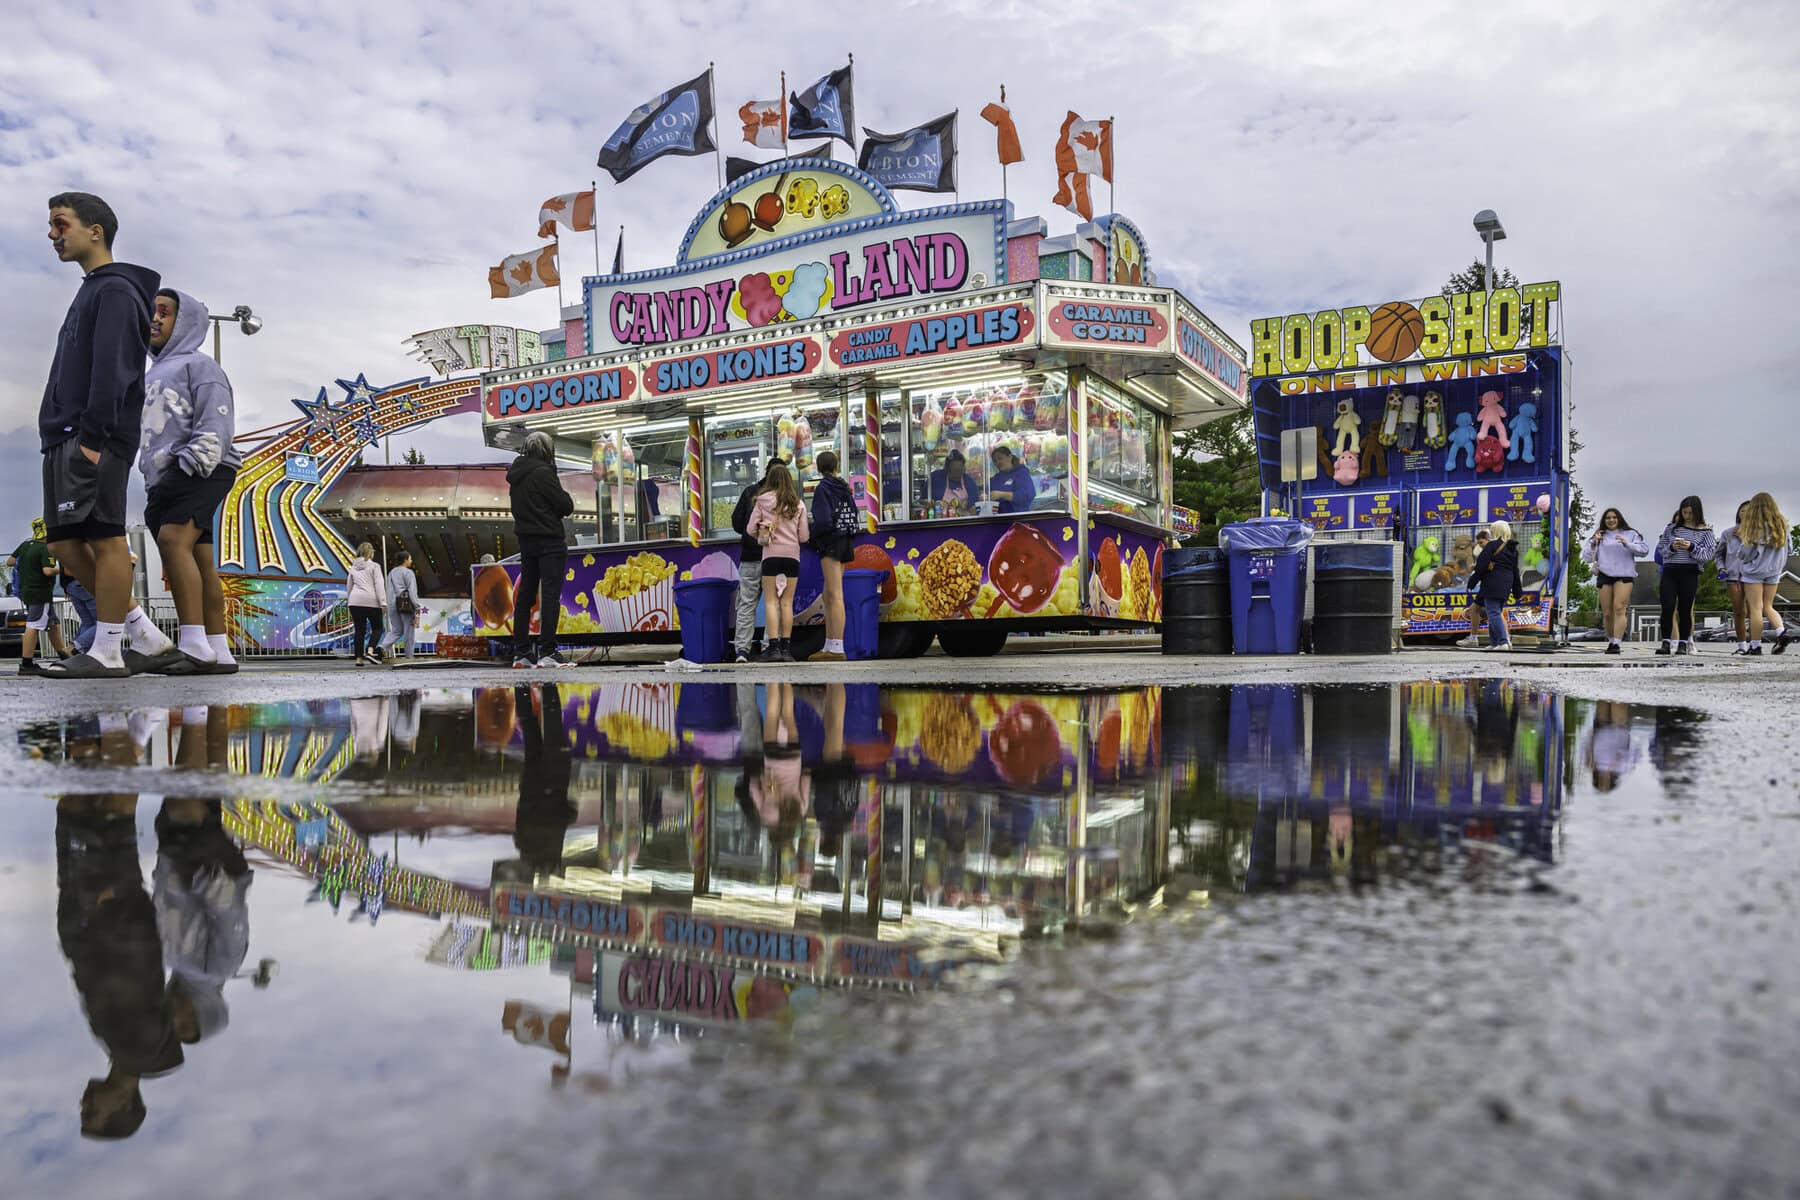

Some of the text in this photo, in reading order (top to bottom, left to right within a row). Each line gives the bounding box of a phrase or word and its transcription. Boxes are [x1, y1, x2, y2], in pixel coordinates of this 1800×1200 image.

[609, 232, 969, 344] CANDY LAND
[905, 307, 1020, 355] APPLES
[1063, 304, 1154, 325] CARAMEL
[1072, 323, 1146, 342] CORN
[1250, 281, 1560, 377] HOOP SHOT
[840, 343, 900, 364] CARAMEL
[848, 327, 892, 347] CANDY
[1180, 319, 1242, 392] COTTON CANDY
[657, 342, 806, 392] SNO KONES
[1281, 355, 1526, 395] ONE IN WINS
[500, 371, 621, 415] POPCORN
[1412, 595, 1445, 607] ONE
[1450, 593, 1467, 606] IN
